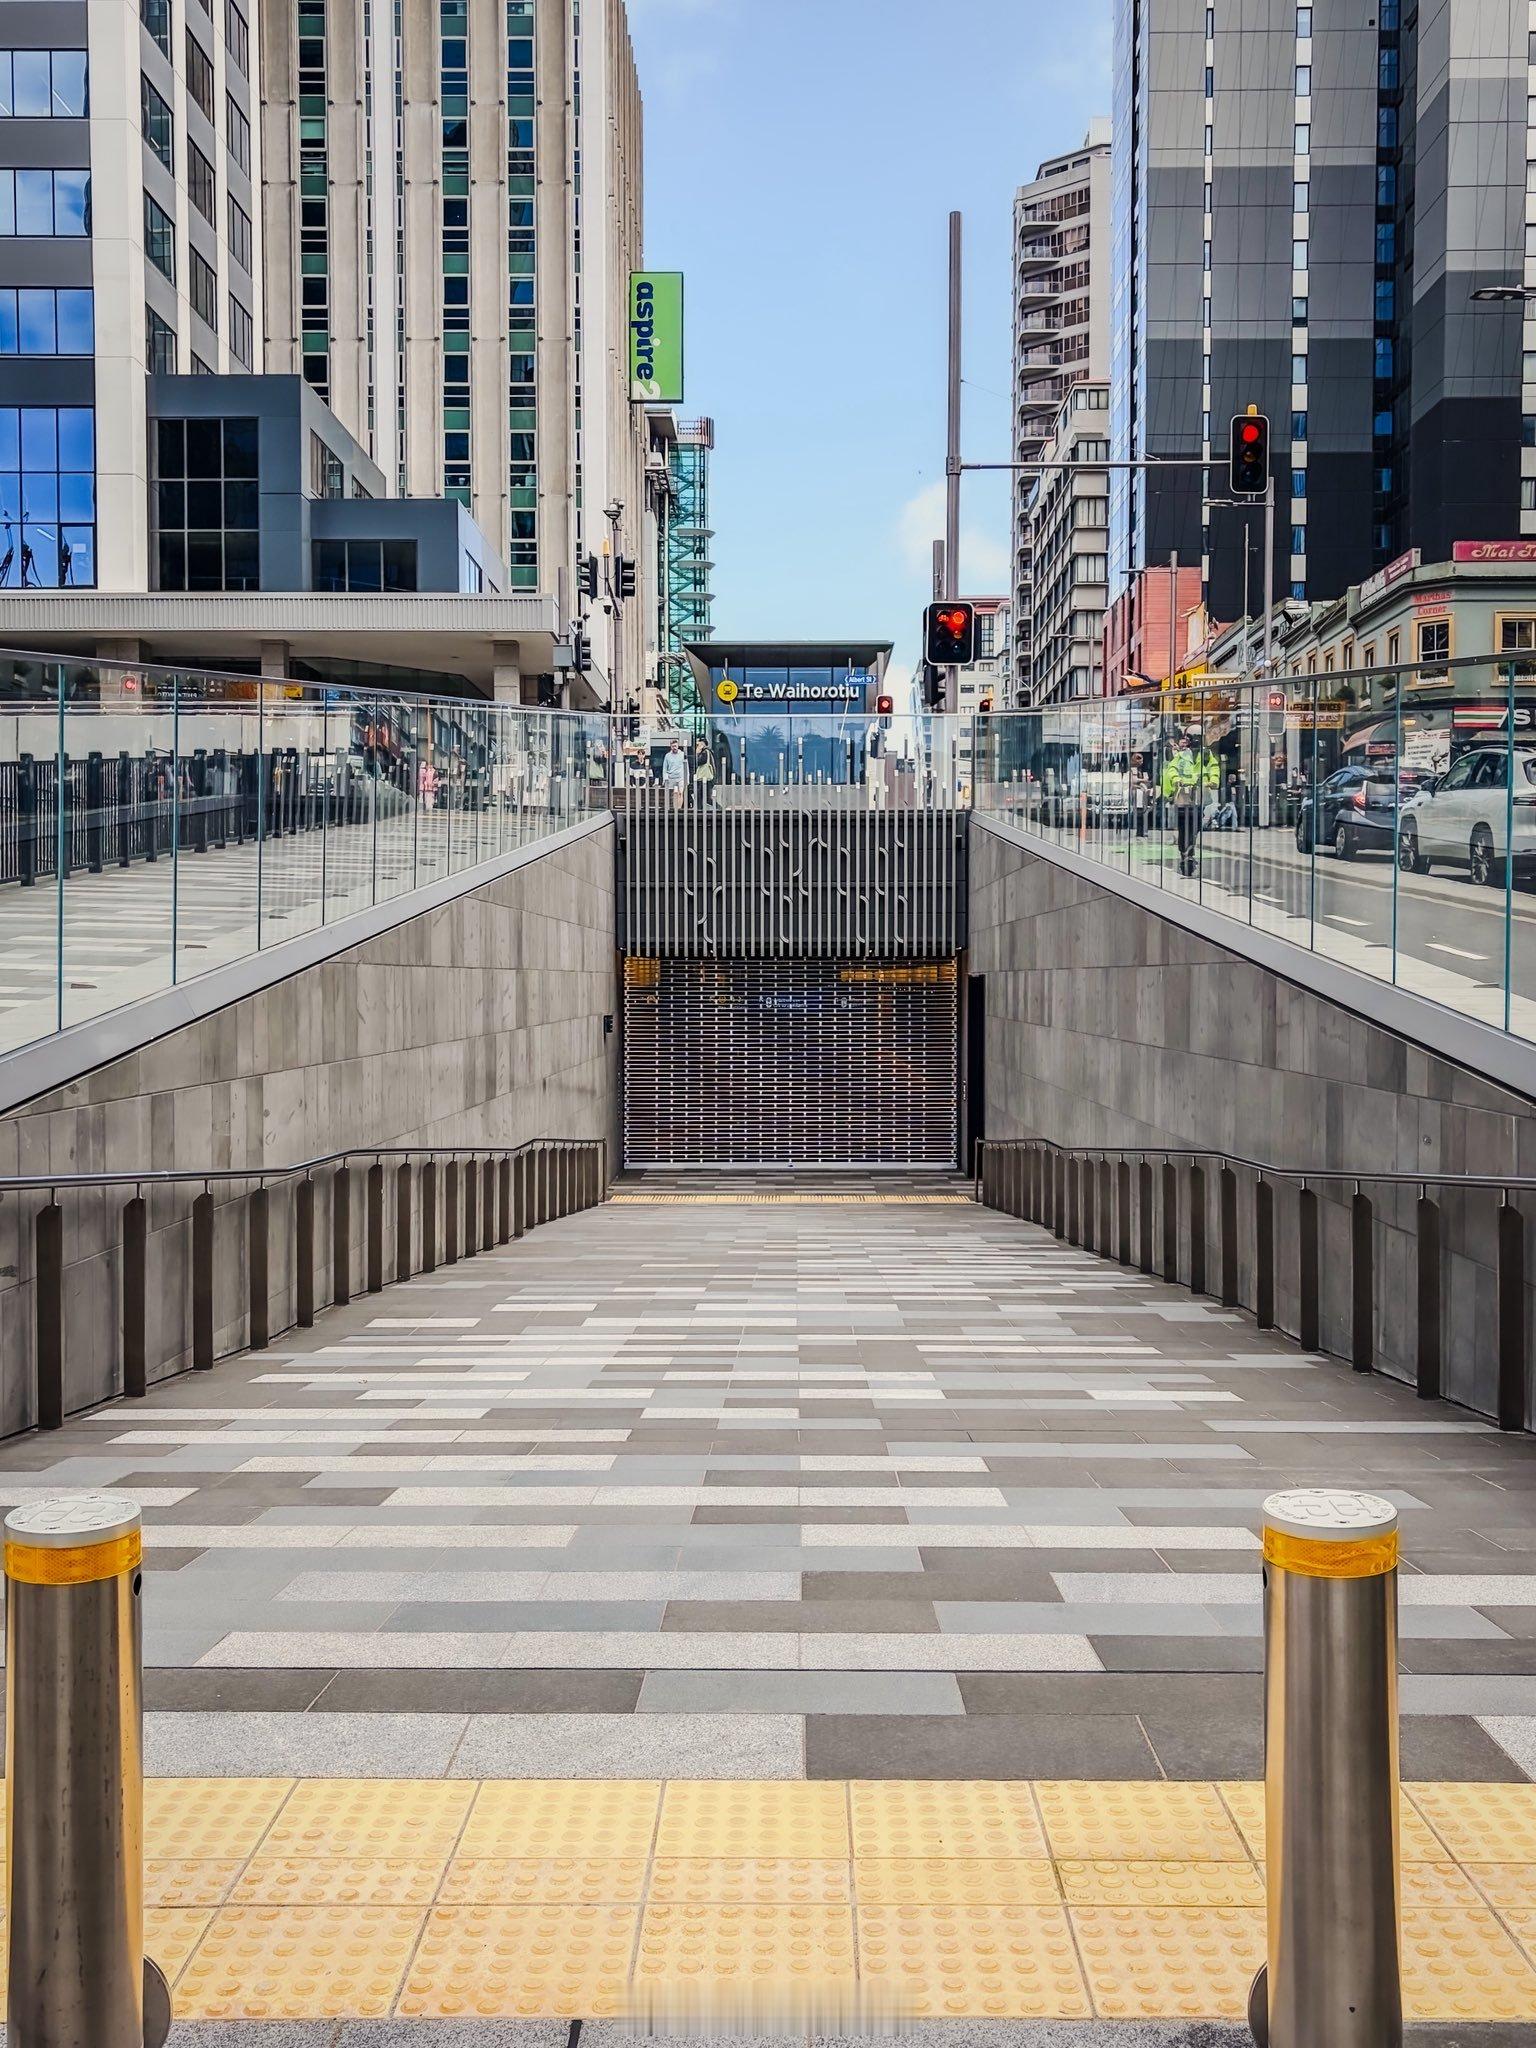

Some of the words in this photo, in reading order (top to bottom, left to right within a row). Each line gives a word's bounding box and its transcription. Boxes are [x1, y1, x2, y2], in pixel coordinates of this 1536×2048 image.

[1471, 544, 1514, 558] Mai
[743, 683, 764, 698] Te
[769, 683, 860, 699] Waihorotiu
